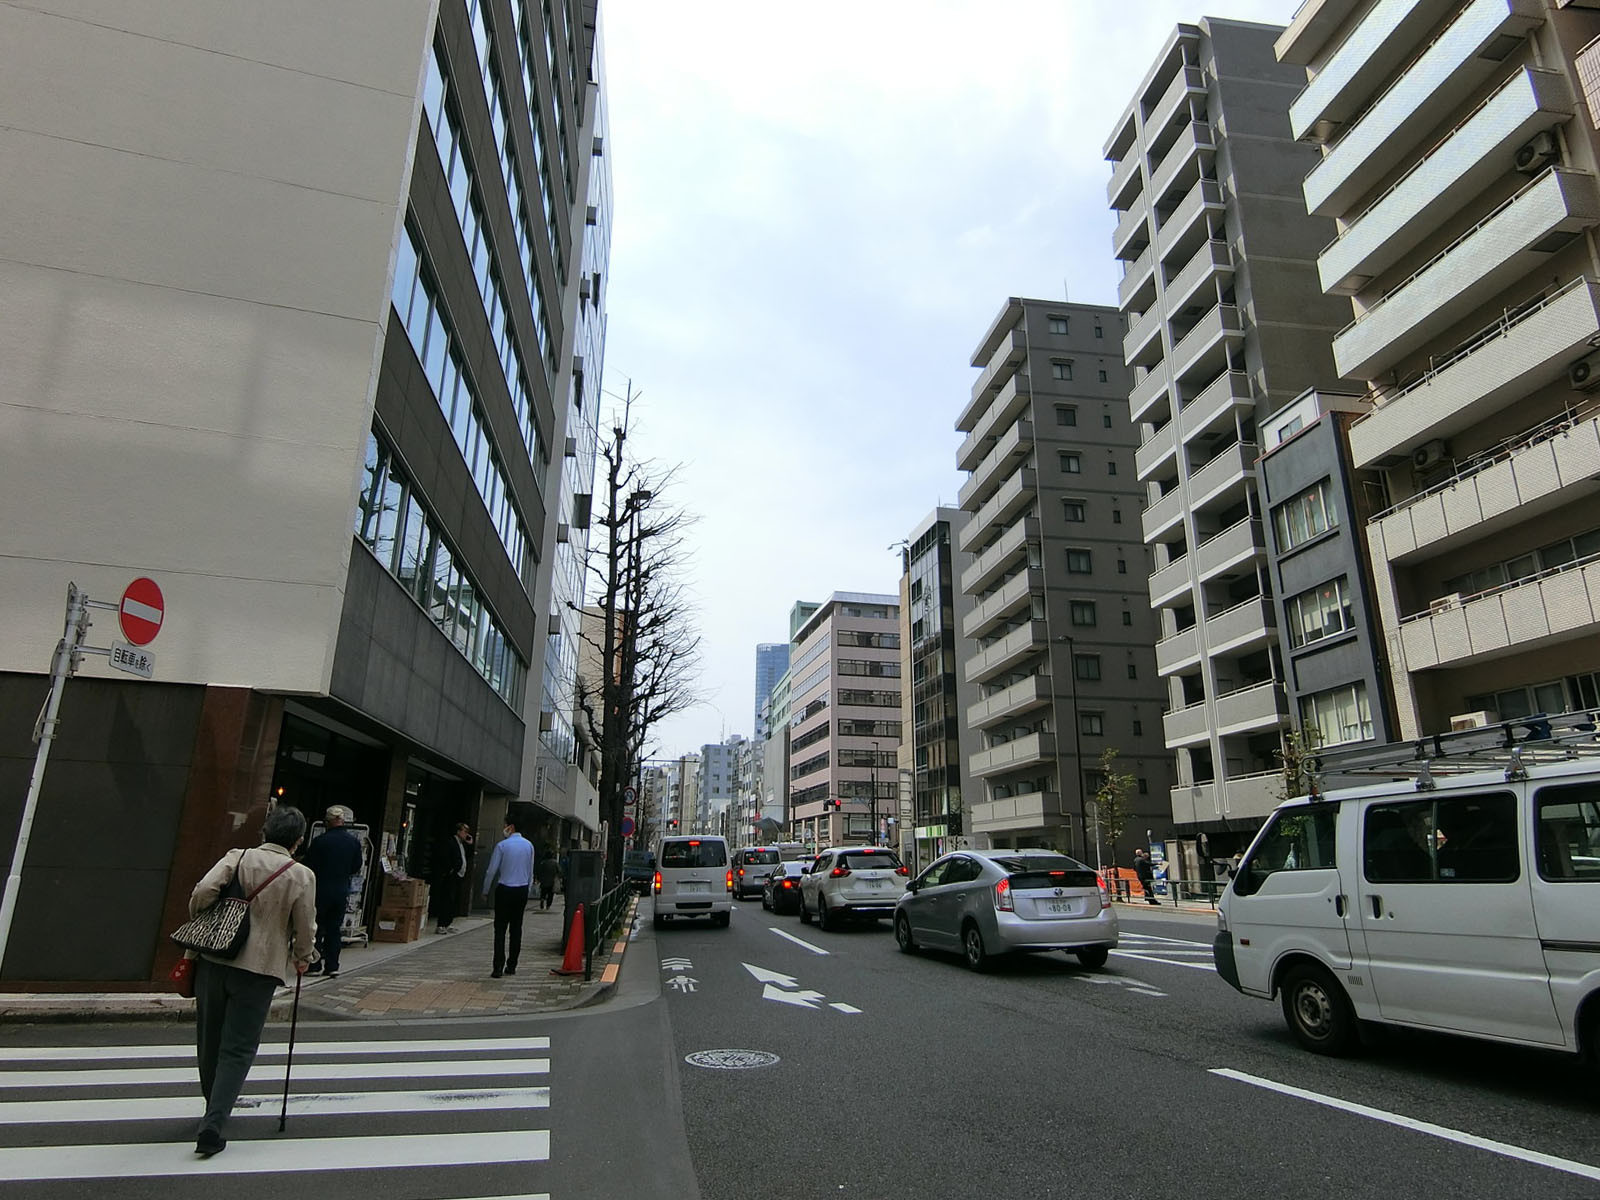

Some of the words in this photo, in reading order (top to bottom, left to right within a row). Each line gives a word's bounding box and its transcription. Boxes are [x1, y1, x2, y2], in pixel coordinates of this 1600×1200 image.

[113, 647, 152, 672] 自転車を除く
